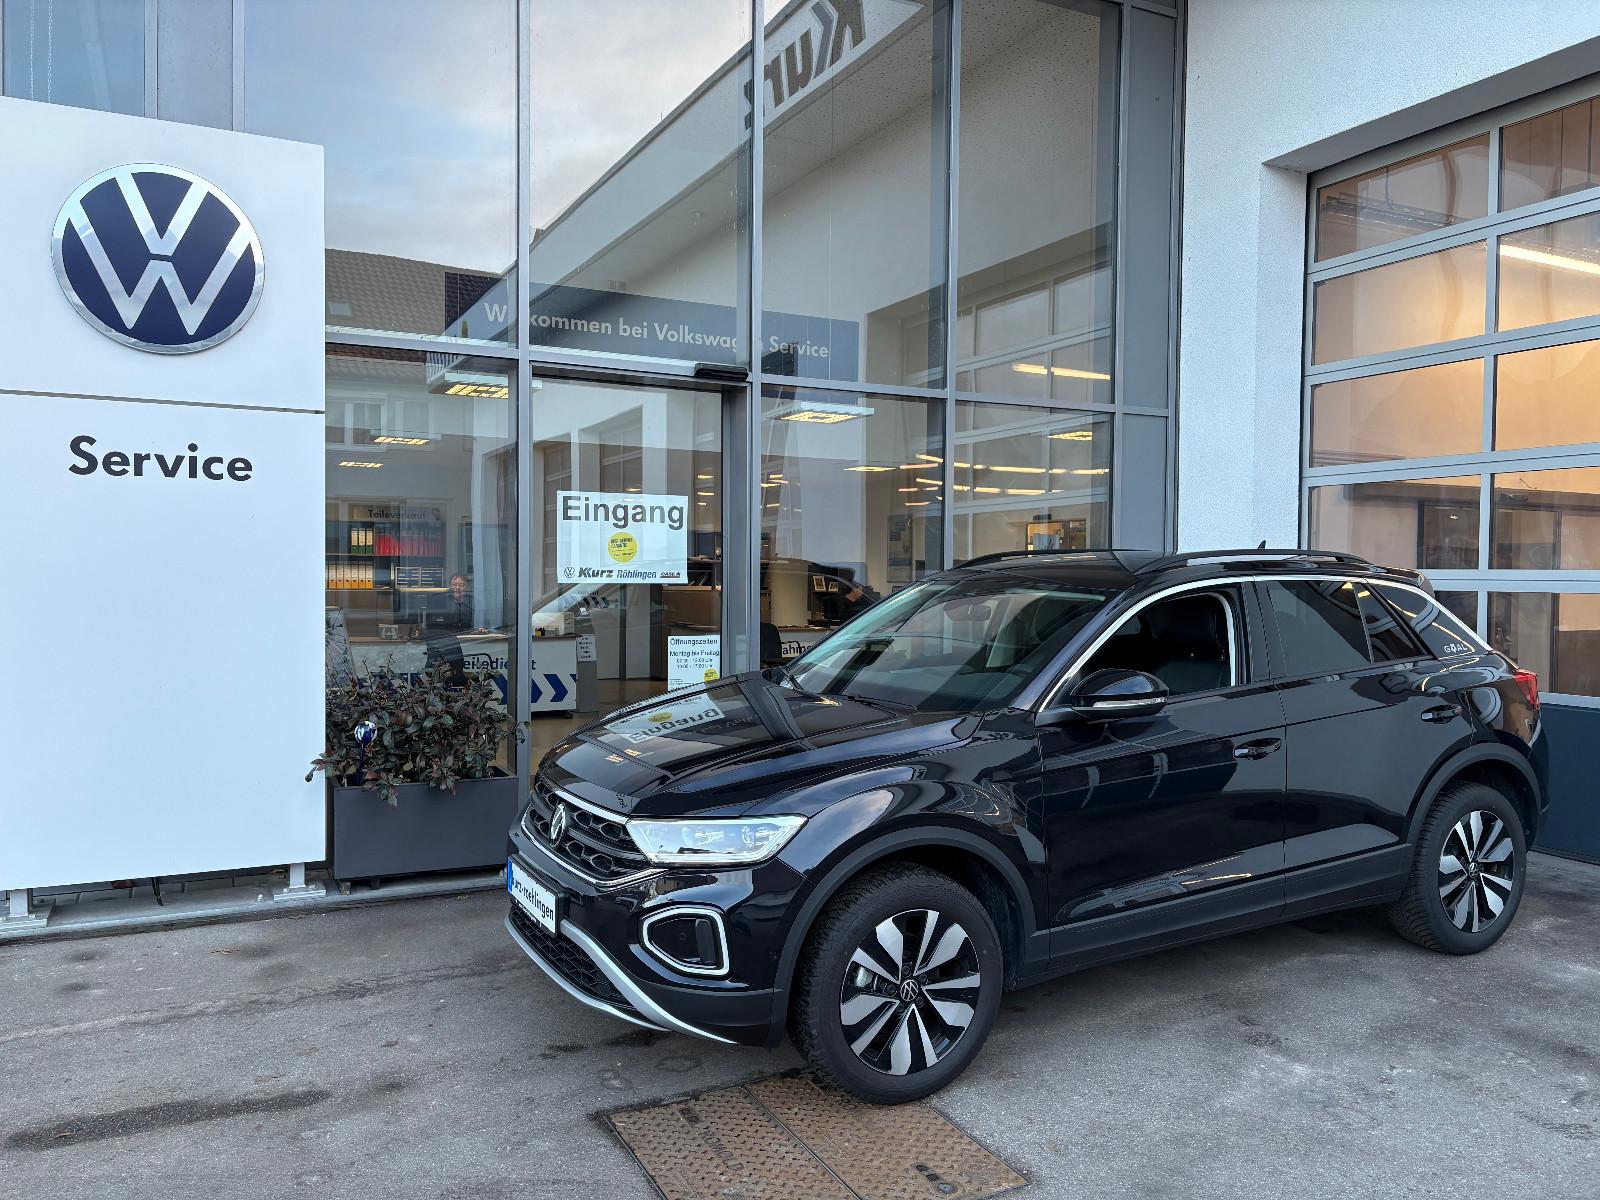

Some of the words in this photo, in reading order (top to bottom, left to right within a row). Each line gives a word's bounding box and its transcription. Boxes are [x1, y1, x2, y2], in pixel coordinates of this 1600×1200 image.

[484, 302, 612, 335] Wkommen
[619, 318, 648, 339] bei
[769, 335, 829, 358] Service
[68, 435, 253, 482] Service
[562, 495, 684, 530] Eingang
[616, 569, 657, 580] Röhlingen
